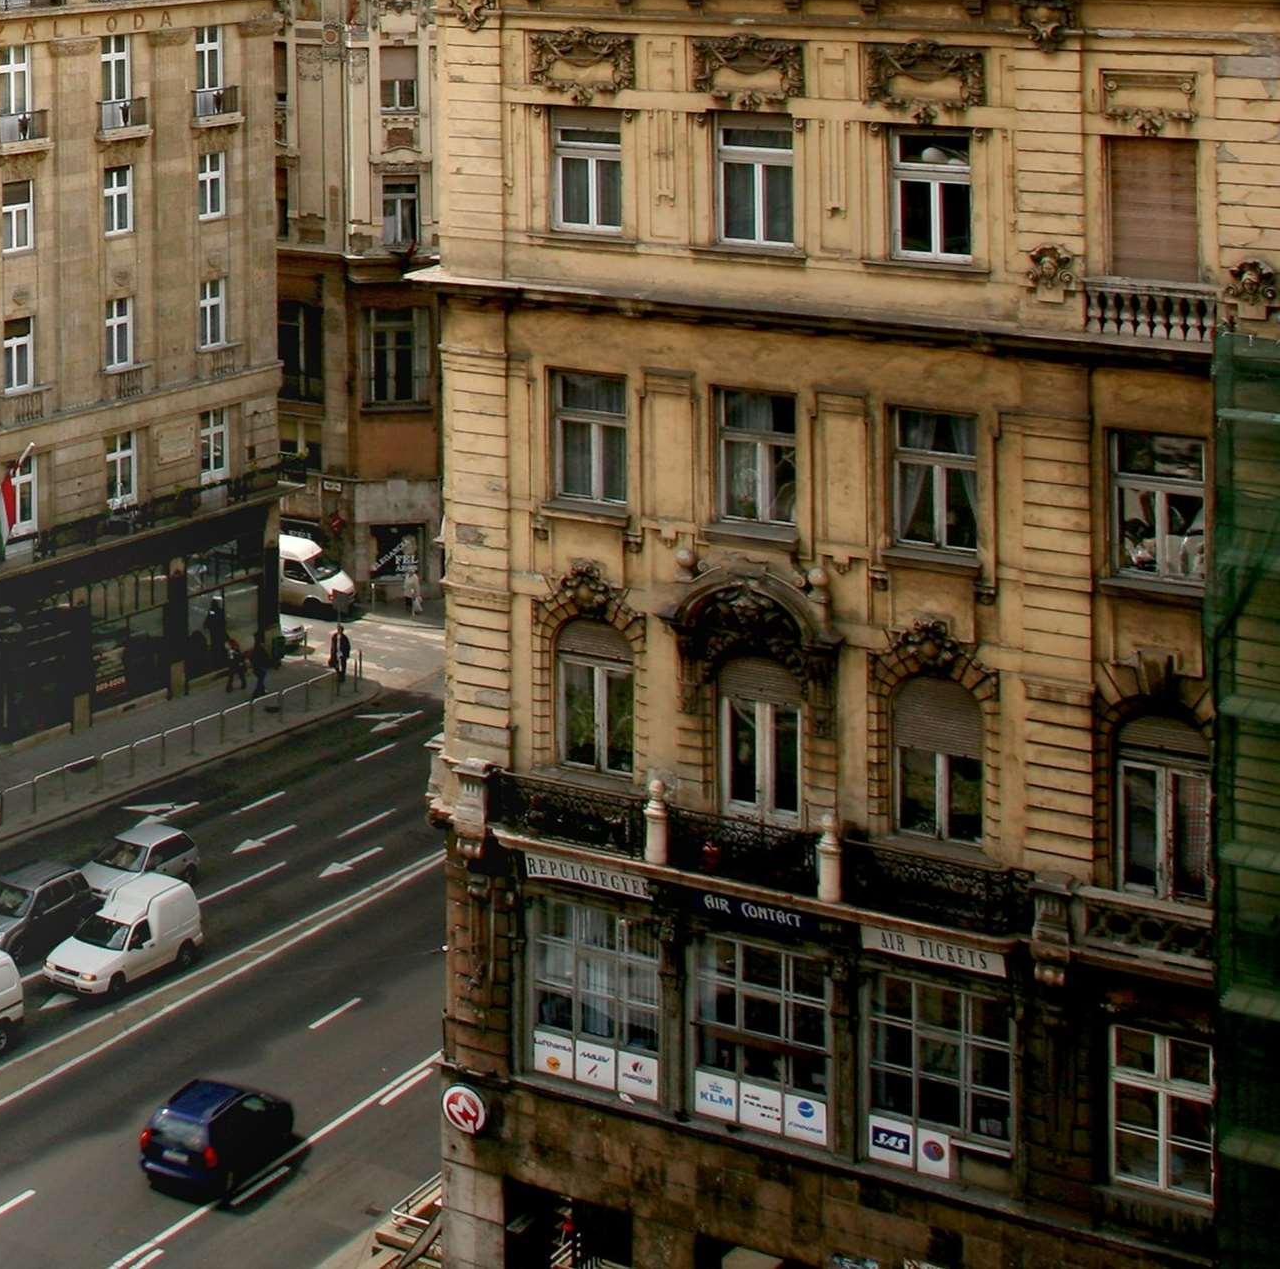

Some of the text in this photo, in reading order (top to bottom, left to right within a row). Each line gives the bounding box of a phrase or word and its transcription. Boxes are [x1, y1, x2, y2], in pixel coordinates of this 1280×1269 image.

[703, 893, 802, 928] AIR CONTACT
[881, 931, 988, 969] AIR TICKETS
[700, 1091, 733, 1106] KLM
[875, 1132, 907, 1150] SAS
